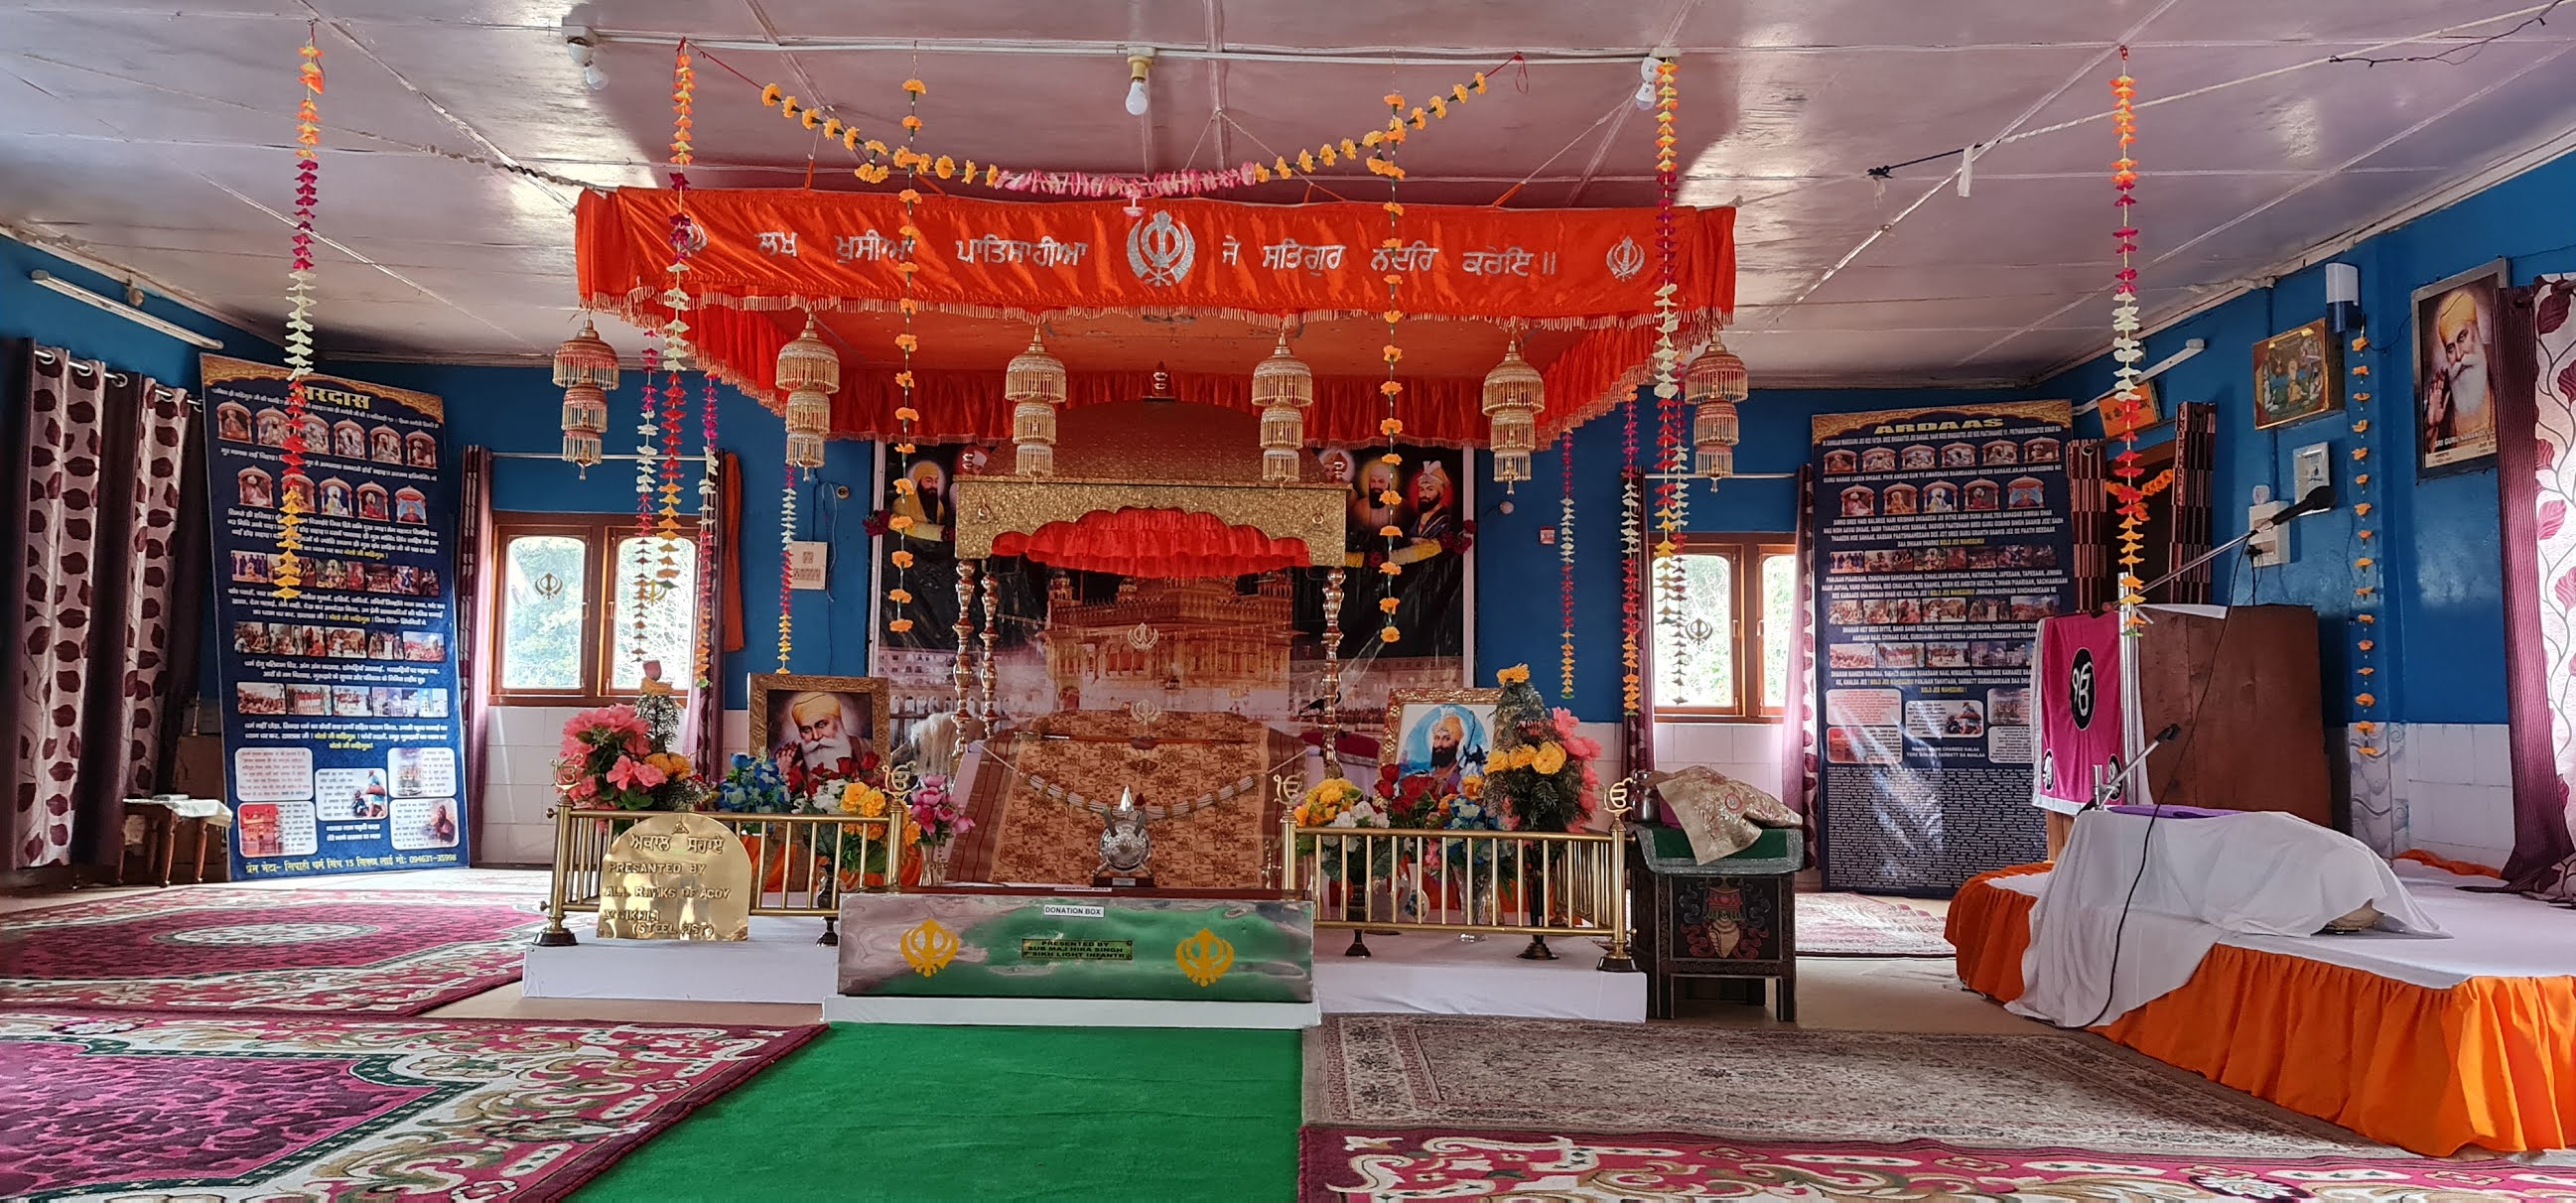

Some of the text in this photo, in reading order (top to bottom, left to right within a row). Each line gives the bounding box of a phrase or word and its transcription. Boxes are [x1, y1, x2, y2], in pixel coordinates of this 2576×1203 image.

[755, 230, 798, 258] ਲਖ
[1222, 234, 1241, 266] ਜੇ
[1262, 238, 1347, 277] ਸਤਿਗੁਰ
[1873, 418, 2004, 435] ARDAAS
[629, 834, 725, 854] ਅਕਾਲ ਸਹਾਏ
[344, 859, 354, 868] 15
[608, 862, 707, 874] PRESANTED BY
[681, 887, 698, 898] OF
[1045, 906, 1083, 915] DONATION
[631, 921, 678, 937] (STEEL
